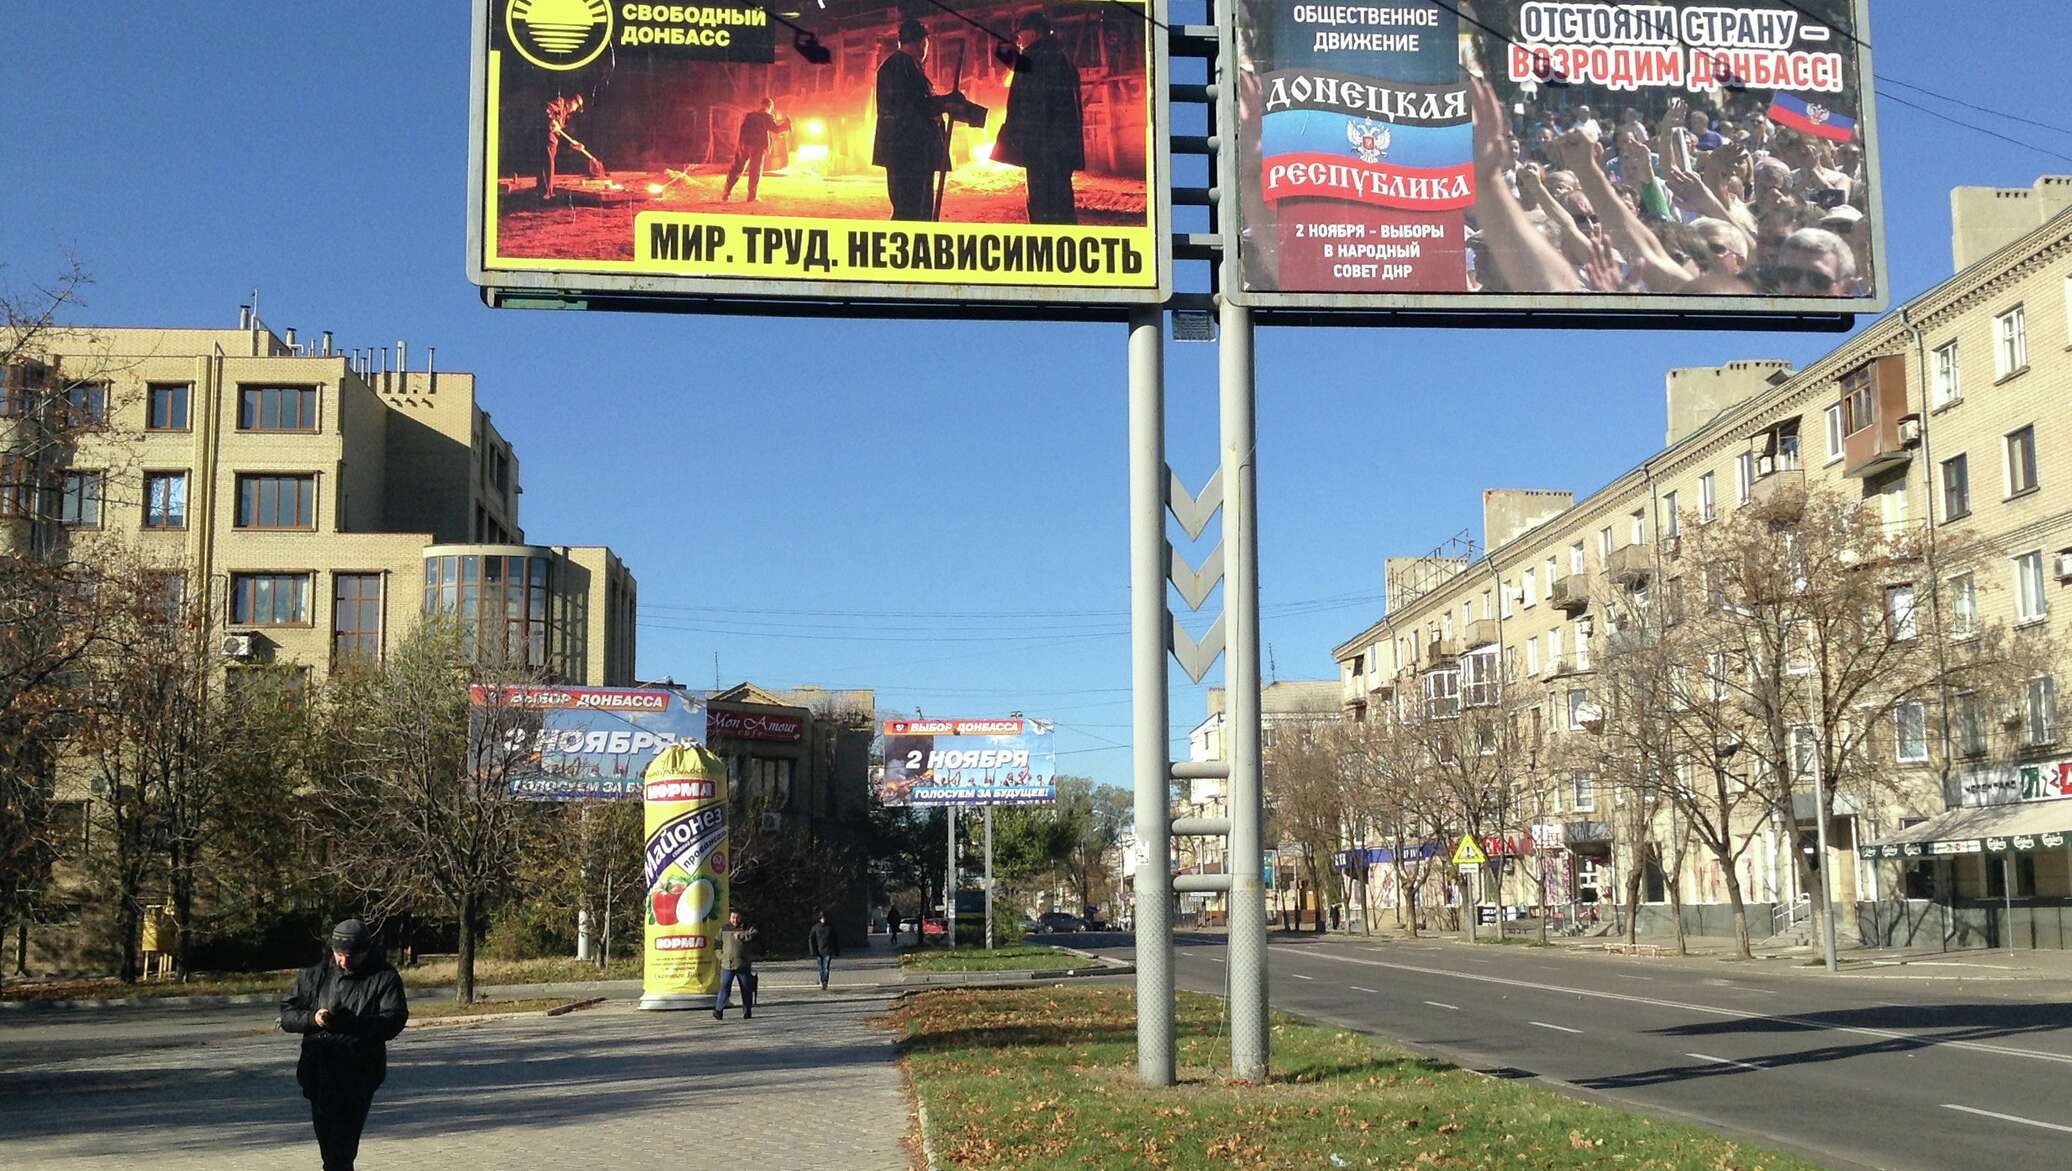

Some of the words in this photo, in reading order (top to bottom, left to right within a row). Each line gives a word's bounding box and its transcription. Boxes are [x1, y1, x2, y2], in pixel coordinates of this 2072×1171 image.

[622, 3, 767, 27] СВОБОДНЫЙ
[1293, 5, 1439, 26] ОБЩЕСТВЕННОЕ
[1524, 5, 1674, 41] ОТСТОЯЛИ
[1685, 10, 1794, 45] СТРАНУ
[620, 26, 731, 47] ДОНБАСС
[1313, 32, 1420, 52] ДВИЖЕНИЕ
[1512, 46, 1680, 87] ВОЗРОДИМ
[1691, 50, 1839, 88] ДОНБАСС!
[1266, 75, 1468, 122] ДОНЕЦКАЯ
[1267, 162, 1471, 200] РЕСПУБЛИКА
[1295, 224, 1304, 238] 2
[1309, 223, 1365, 238] НОЯБРЯ
[1381, 224, 1444, 238] ВЫБОРЫ
[649, 223, 734, 264] МИР.
[742, 226, 839, 273] ТРУД.
[847, 230, 1143, 275] НЕЗАВИСИМОСТЬ
[1324, 244, 1333, 258] В
[1337, 241, 1421, 260] НАРОДНЫЙ
[1333, 264, 1378, 278] СОВЕТ
[1381, 265, 1413, 280] ДНР
[575, 693, 663, 708] ДОНБАССА
[707, 712, 741, 729] Mon
[743, 715, 798, 733] Amour
[910, 722, 953, 732] ВЫБОР
[956, 722, 1019, 733] ДОНБАССА
[503, 727, 526, 751] 2
[532, 728, 676, 755] НОЯБРЯ
[906, 750, 923, 769] 2
[927, 750, 1029, 769] НОЯБРЯ
[602, 780, 622, 793] ЗА
[914, 789, 975, 799] ГОЛОСУЕМ
[976, 789, 992, 798] ЗА
[993, 787, 1049, 799] БУДУЩЕЕ!
[644, 807, 723, 889] Майонез
